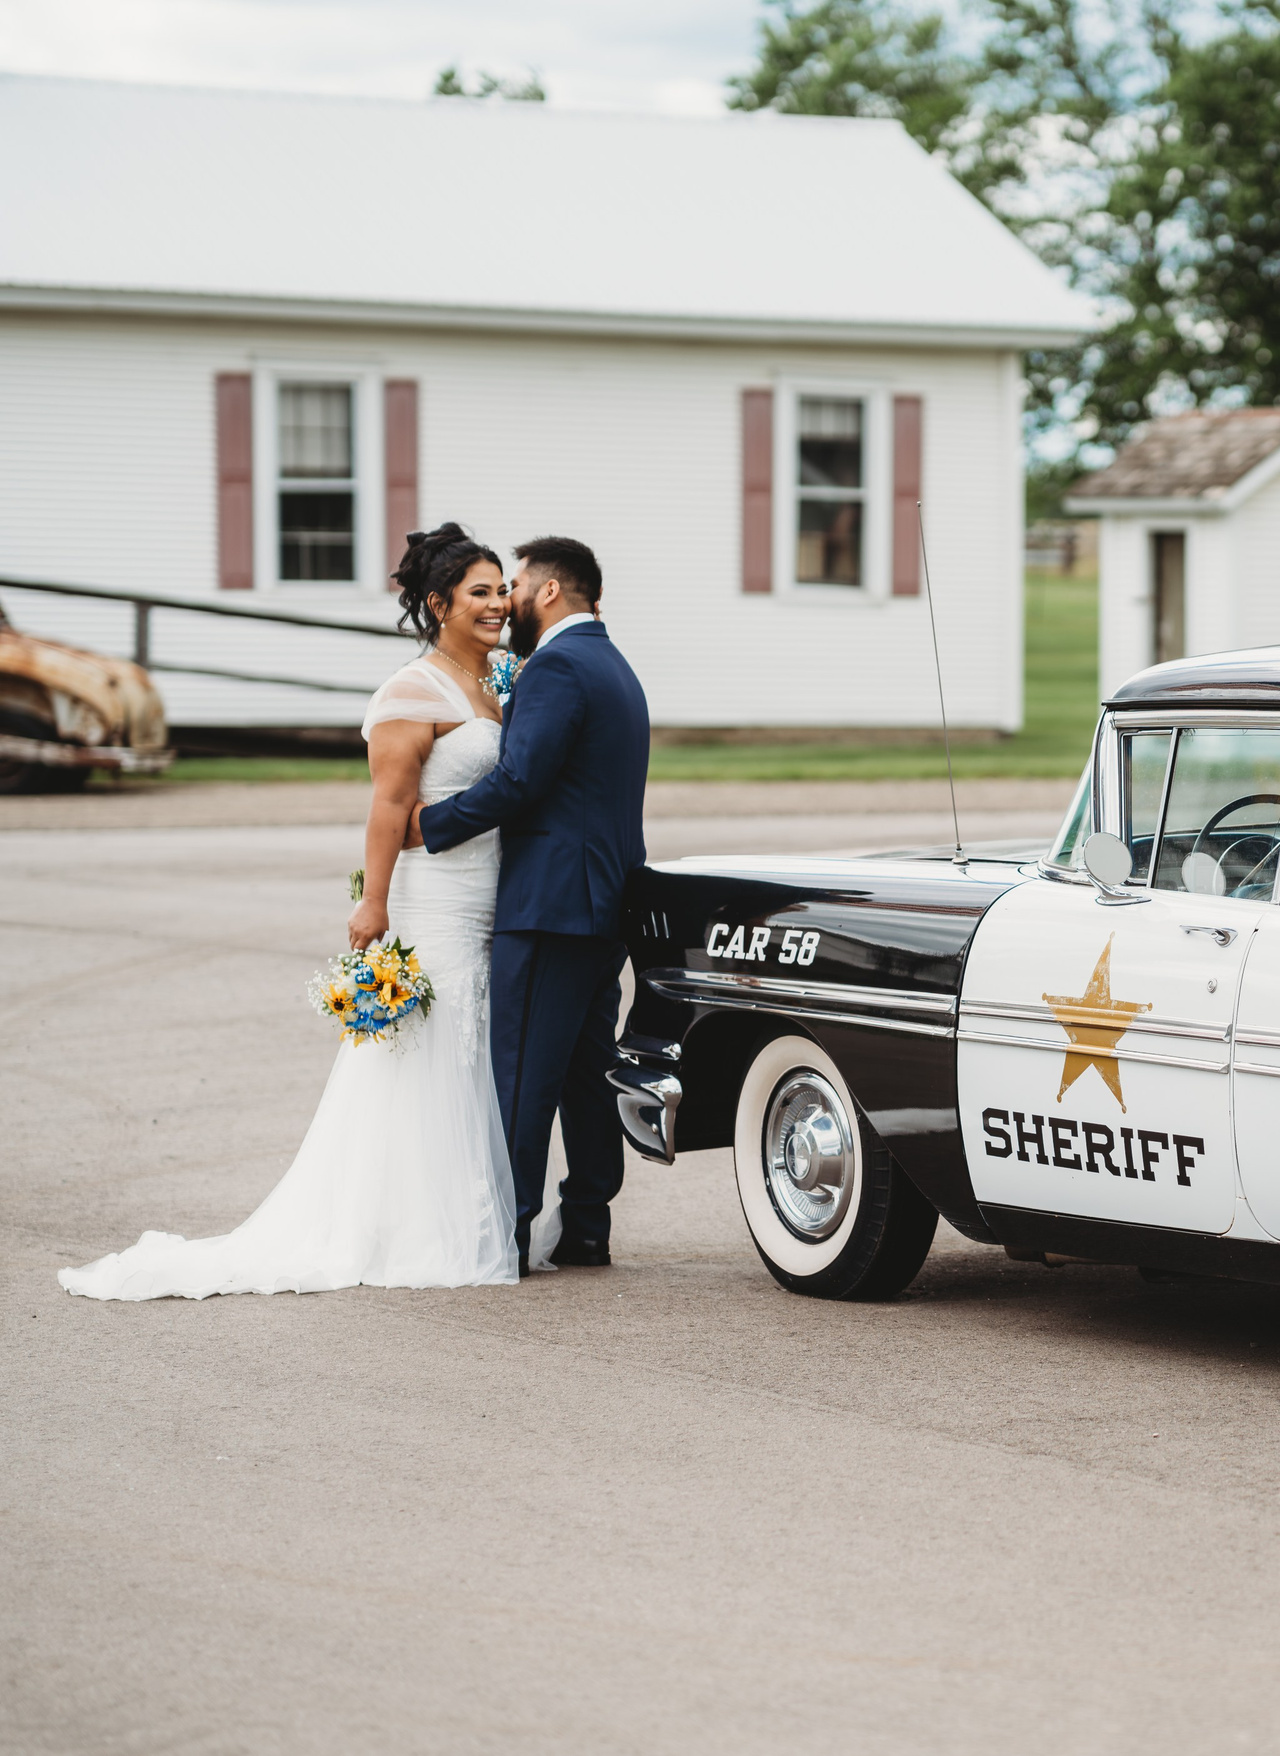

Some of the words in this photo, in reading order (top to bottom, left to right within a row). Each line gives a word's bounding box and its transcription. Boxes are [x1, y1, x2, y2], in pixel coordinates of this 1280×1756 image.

[706, 923, 771, 961] CAR
[778, 929, 820, 966] 58
[982, 1107, 1205, 1187] SHERIFF
